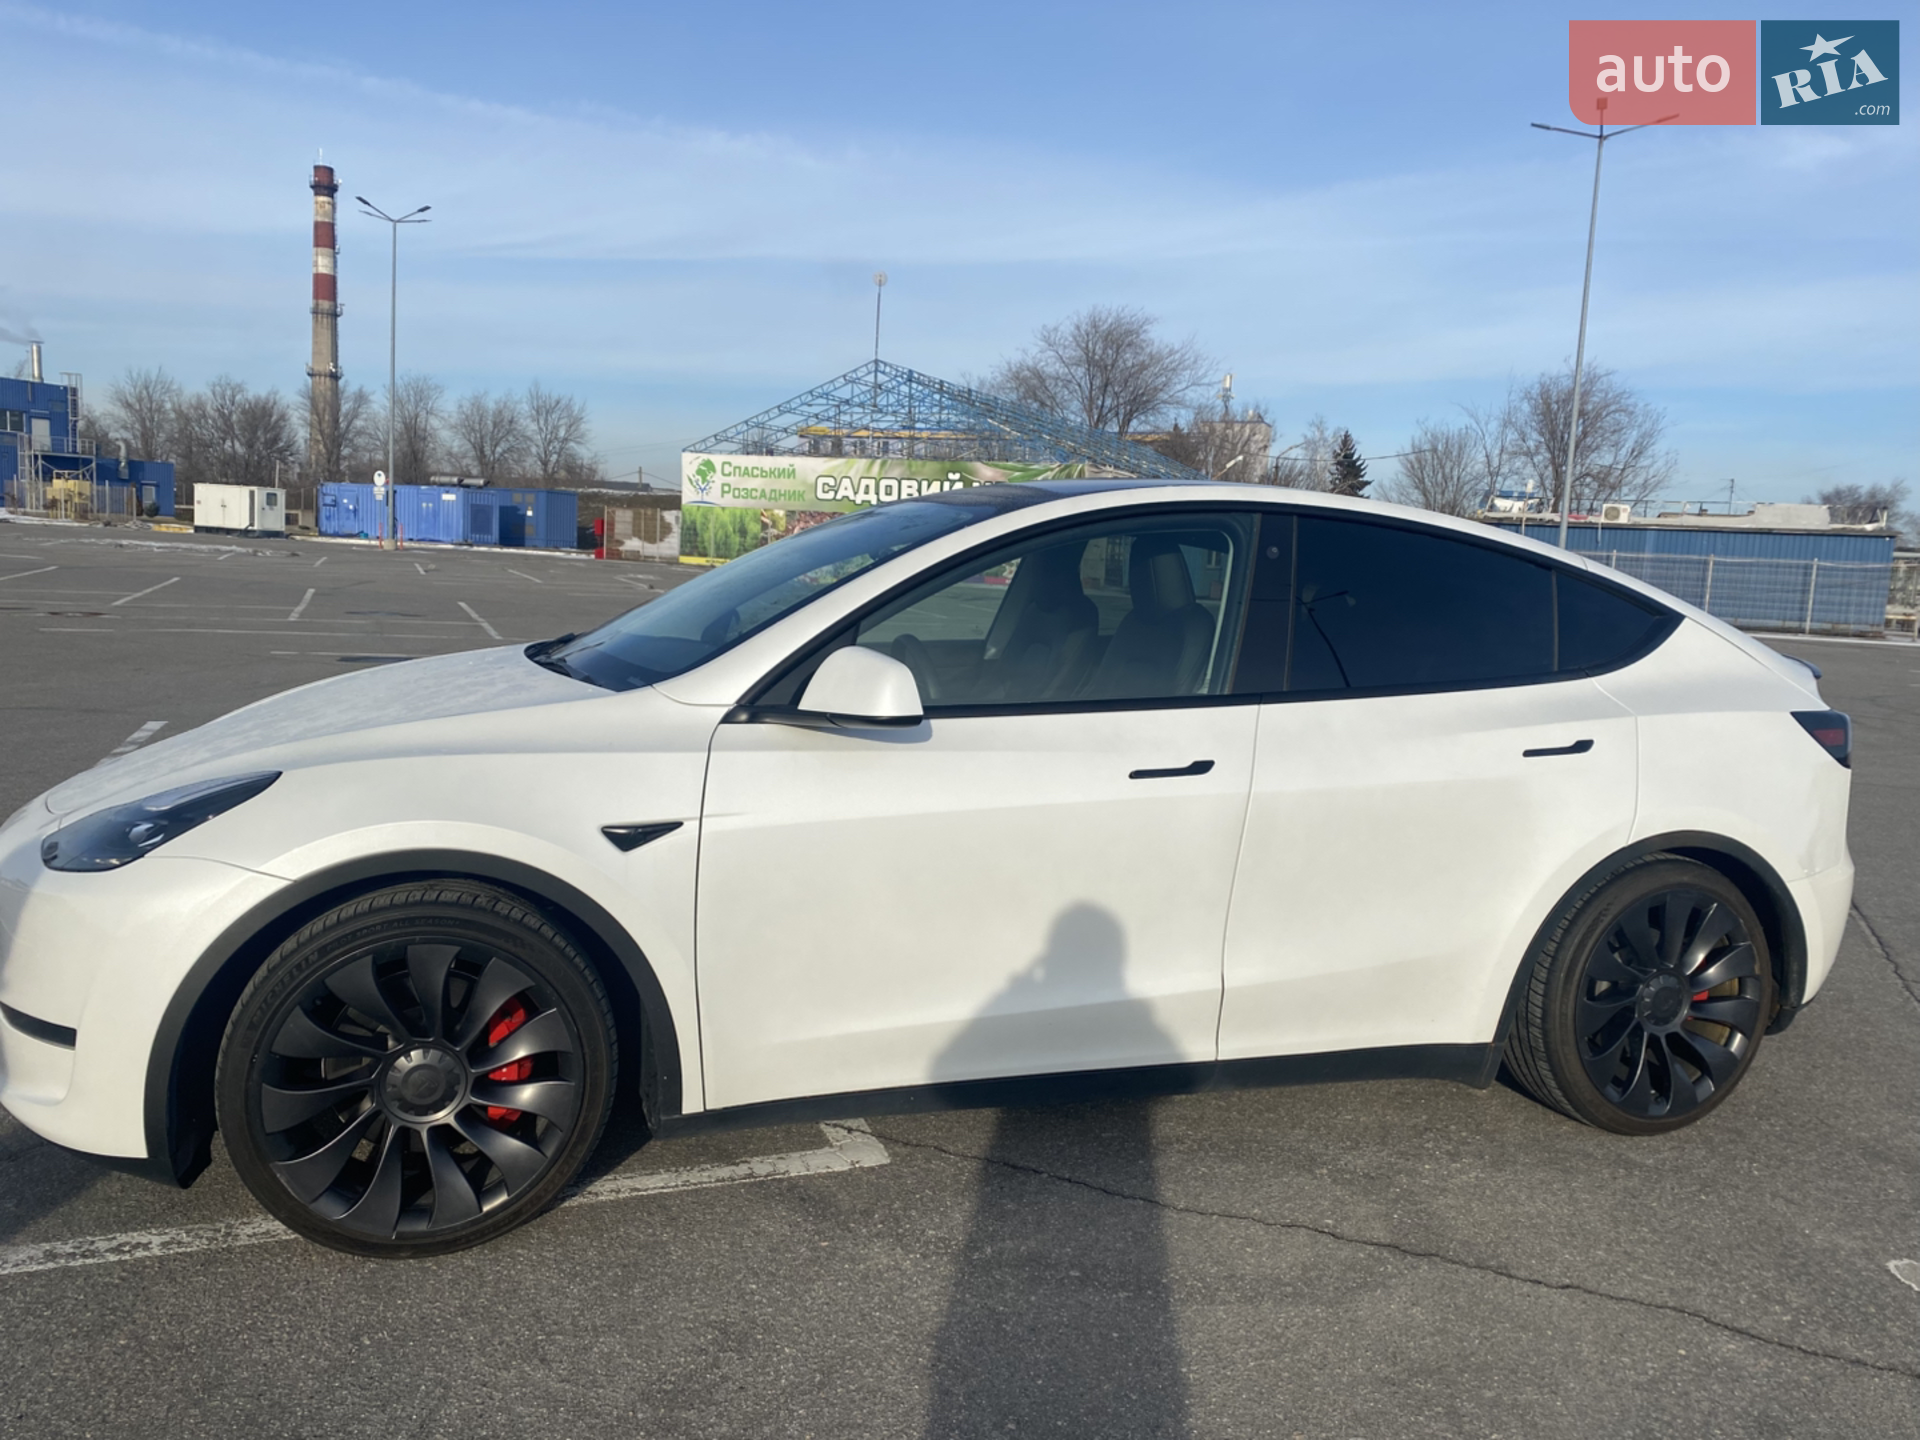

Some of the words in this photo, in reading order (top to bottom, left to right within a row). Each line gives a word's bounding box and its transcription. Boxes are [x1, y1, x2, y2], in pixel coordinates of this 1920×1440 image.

[721, 461, 797, 479] Спаський
[721, 482, 806, 502] Розсадник
[816, 472, 964, 504] САДОВИЙ
[355, 923, 388, 937] SPORT
[392, 918, 410, 928] ALL
[252, 951, 319, 1025] MICHELIN
